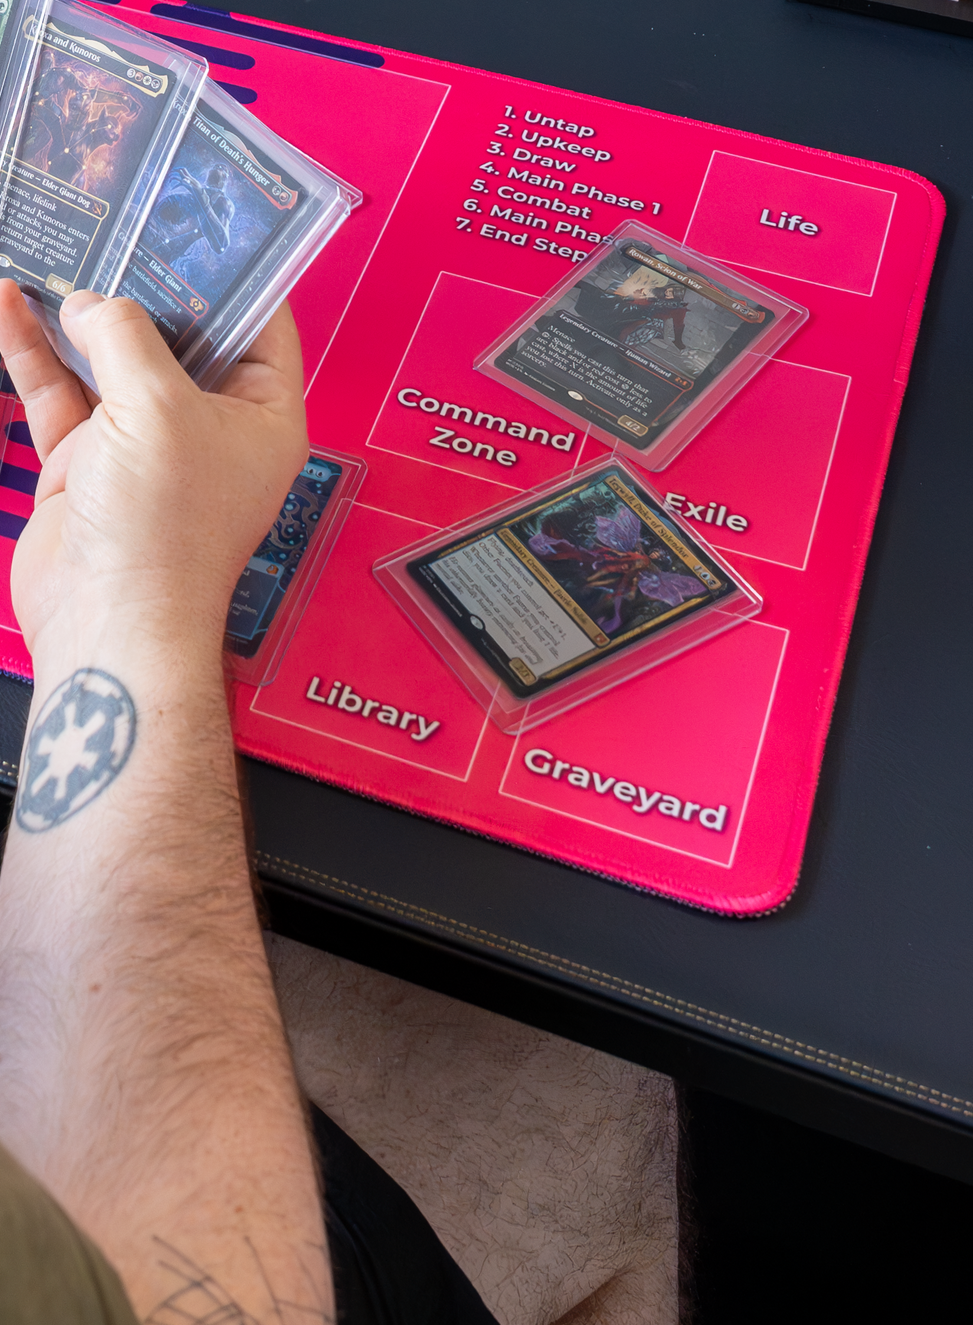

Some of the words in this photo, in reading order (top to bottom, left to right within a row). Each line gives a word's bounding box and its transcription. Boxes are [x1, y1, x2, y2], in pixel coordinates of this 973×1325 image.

[53, 35, 69, 48] and
[69, 41, 101, 63] Kunoros
[504, 104, 516, 118] 1.
[523, 109, 594, 138] Untap
[193, 115, 211, 136] Titan
[211, 130, 221, 144] of
[219, 139, 244, 164] Death's
[244, 161, 271, 187] Hunger
[485, 140, 505, 156] 3.
[512, 147, 576, 172] Draw
[493, 122, 513, 138] 2.
[520, 128, 611, 162] Upkeep
[33, 194, 57, 212] lifelink
[41, 178, 59, 191] Elder
[59, 186, 77, 200] Giant
[77, 196, 91, 208] Dog
[469, 178, 489, 193] 5.
[496, 185, 591, 219] Combat
[478, 160, 500, 175] 4.
[506, 166, 564, 191] Main
[570, 182, 644, 210] Phase
[651, 201, 660, 215] 1
[462, 197, 482, 213] 6.
[489, 203, 547, 230] Main
[759, 208, 819, 238] Life
[455, 216, 472, 233] 7.
[479, 222, 528, 246] End
[533, 236, 589, 264] Step
[52, 280, 67, 293] 6/6
[149, 260, 166, 280] Elder
[165, 274, 183, 292] Giant
[629, 248, 655, 266] Rowan,
[655, 262, 677, 278] Scion
[677, 272, 688, 284] of
[687, 278, 703, 290] War
[559, 312, 591, 334] Legendary
[591, 330, 618, 350] Creature
[625, 348, 647, 366] Human
[649, 361, 671, 378] Wizard
[397, 386, 577, 452] Command
[429, 426, 519, 468] Zone
[663, 492, 749, 533] Exile
[657, 525, 689, 558] Splendor
[305, 676, 441, 743] Library
[523, 748, 729, 833] Graveyard
